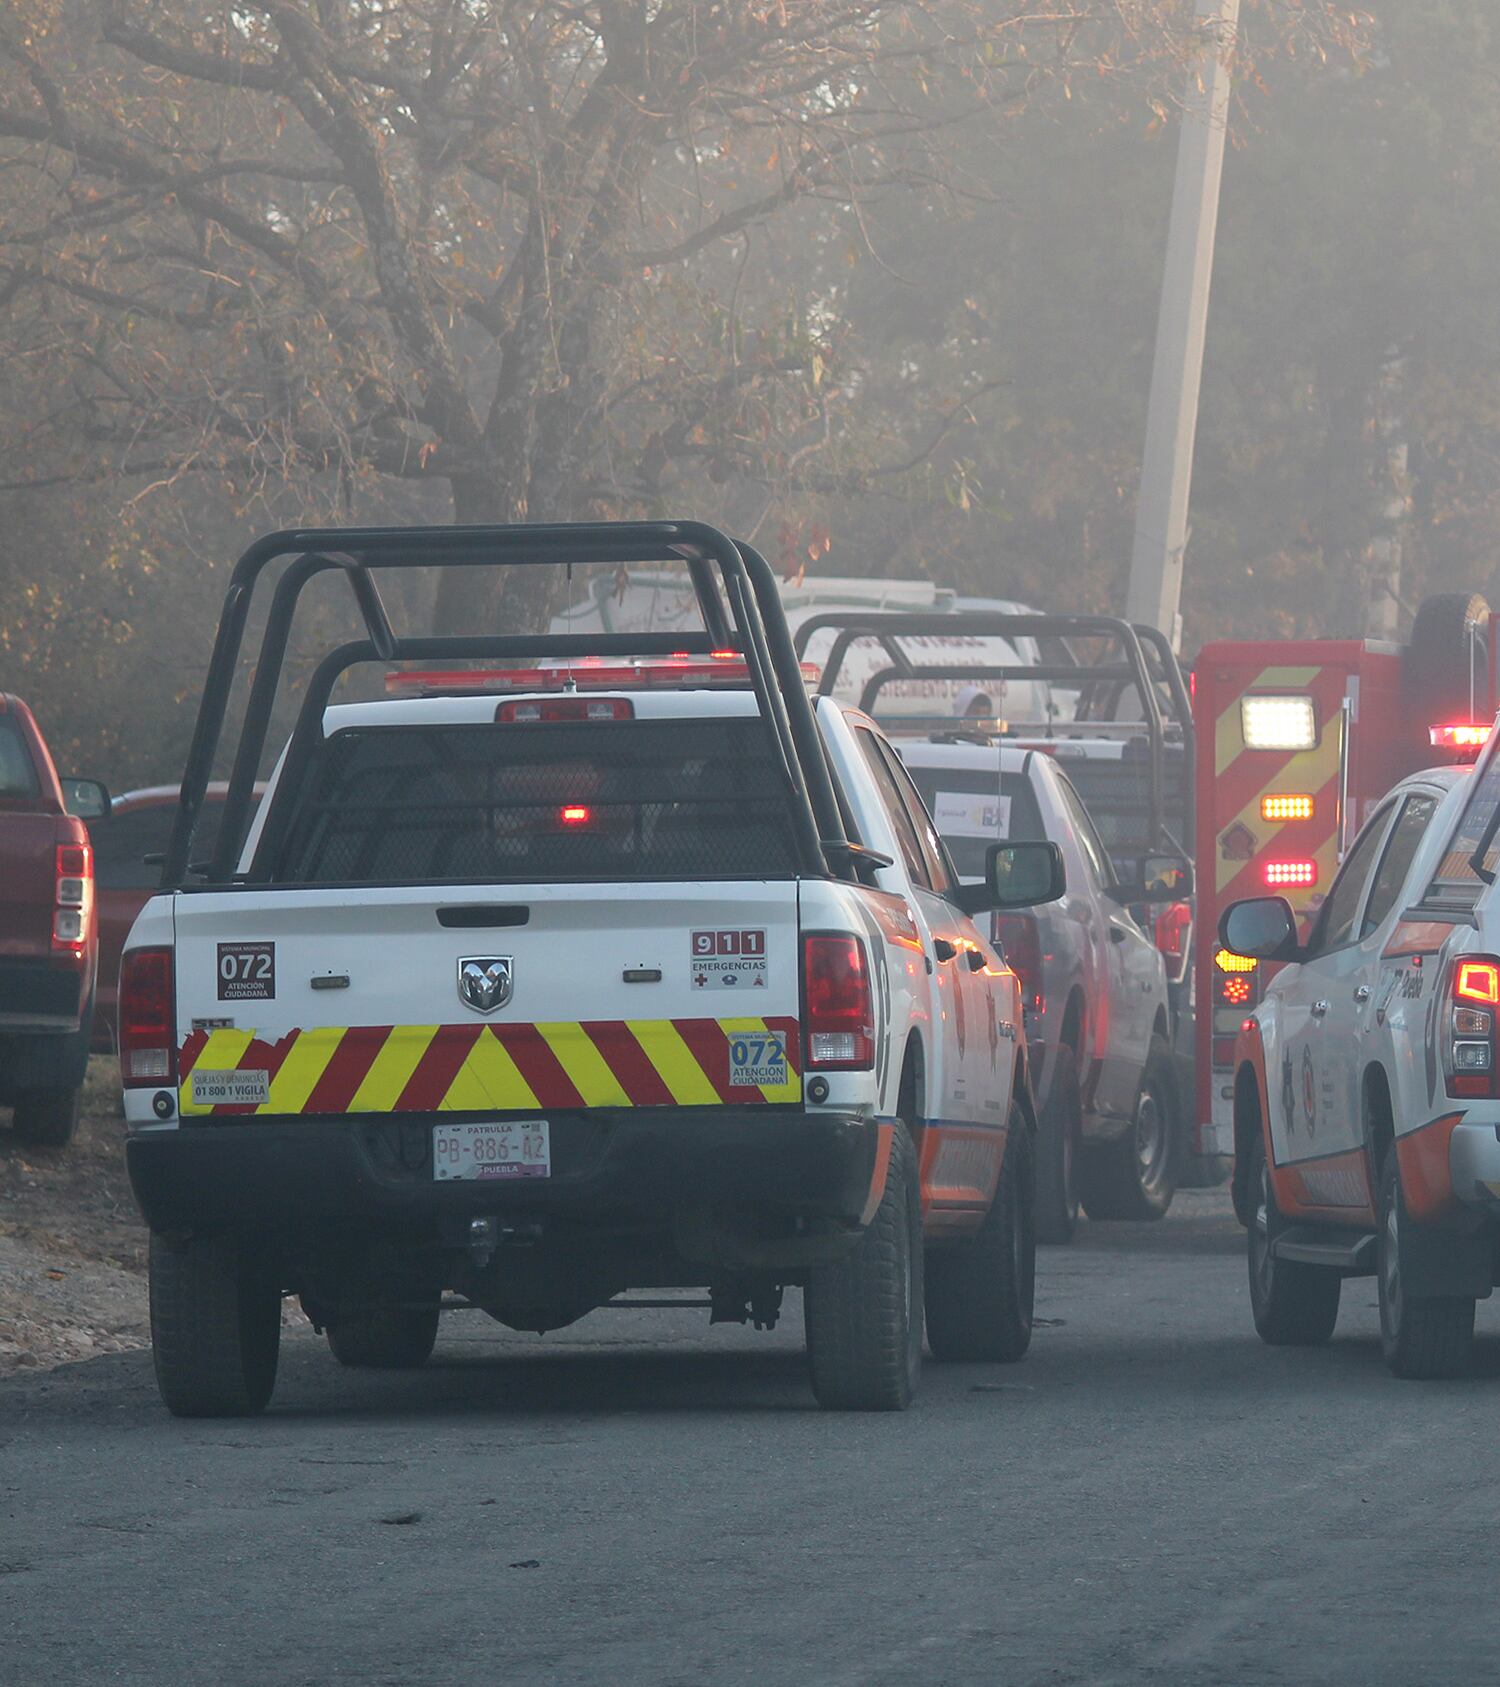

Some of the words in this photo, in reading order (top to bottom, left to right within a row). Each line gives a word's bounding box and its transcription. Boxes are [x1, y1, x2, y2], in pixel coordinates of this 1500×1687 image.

[697, 934, 757, 953] 911
[220, 953, 273, 980] 072
[692, 961, 766, 972] EMERGENCIAS
[224, 990, 268, 998] CIUDADANA
[731, 1040, 784, 1066] 072
[733, 1077, 785, 1085] CIUDADANA
[195, 1086, 206, 1096] 01
[208, 1086, 226, 1096] 800
[234, 1085, 265, 1096] VIGILA
[467, 1126, 513, 1134] PATRULLA
[483, 1166, 519, 1174] PUEBLA
